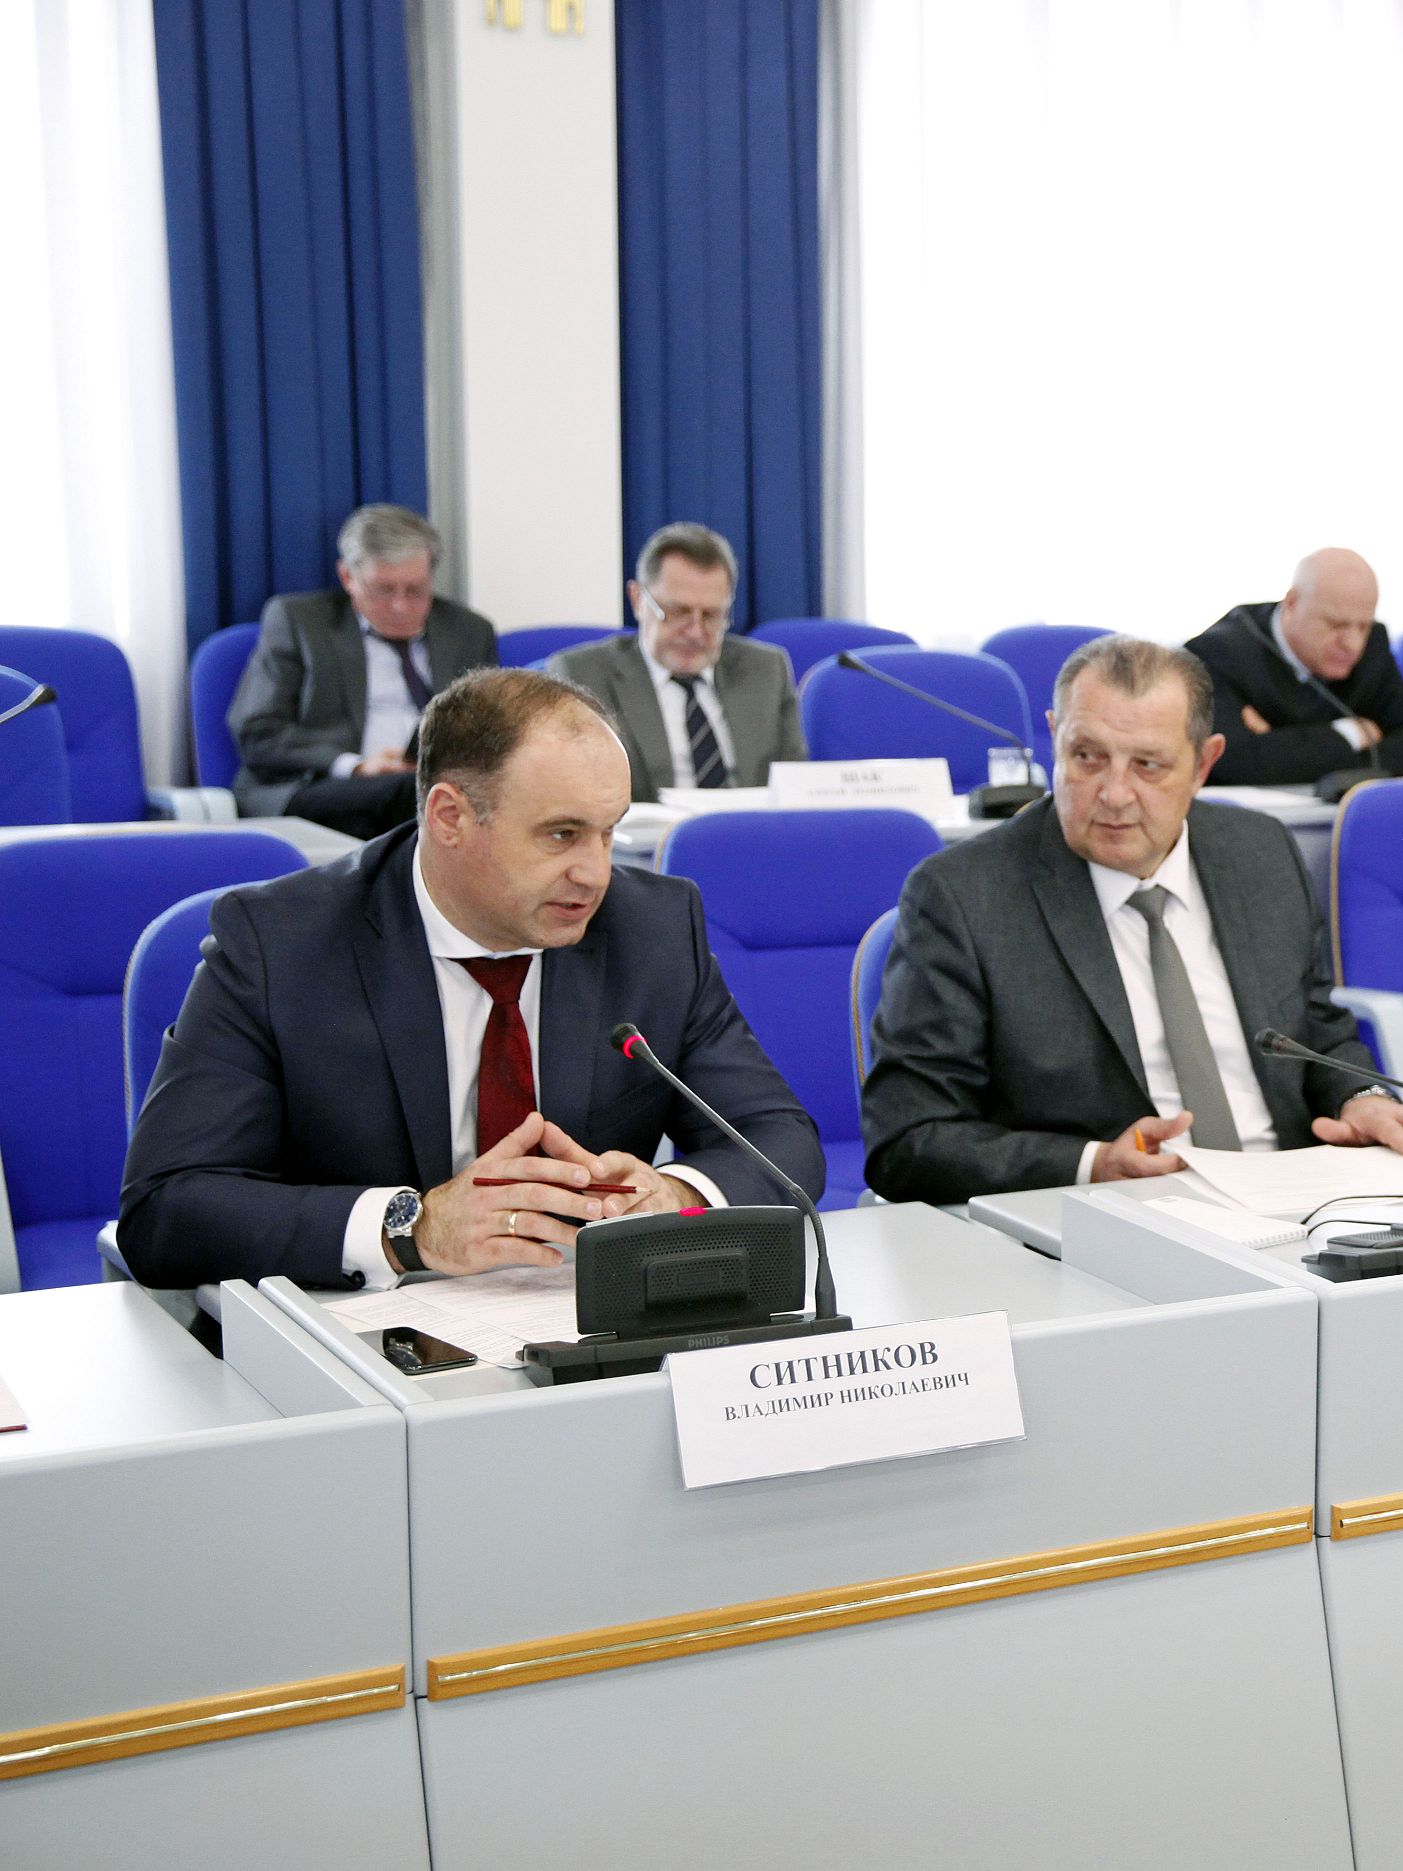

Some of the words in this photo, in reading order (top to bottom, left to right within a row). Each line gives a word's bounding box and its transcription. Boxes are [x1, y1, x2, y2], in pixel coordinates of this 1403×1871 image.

[687, 1335, 730, 1349] PHILIPS
[749, 1341, 939, 1389] СИТНИКОВ
[724, 1392, 834, 1422] ВЛАДИМИР
[840, 1372, 970, 1404] НИКОЛАЕВИЧ
